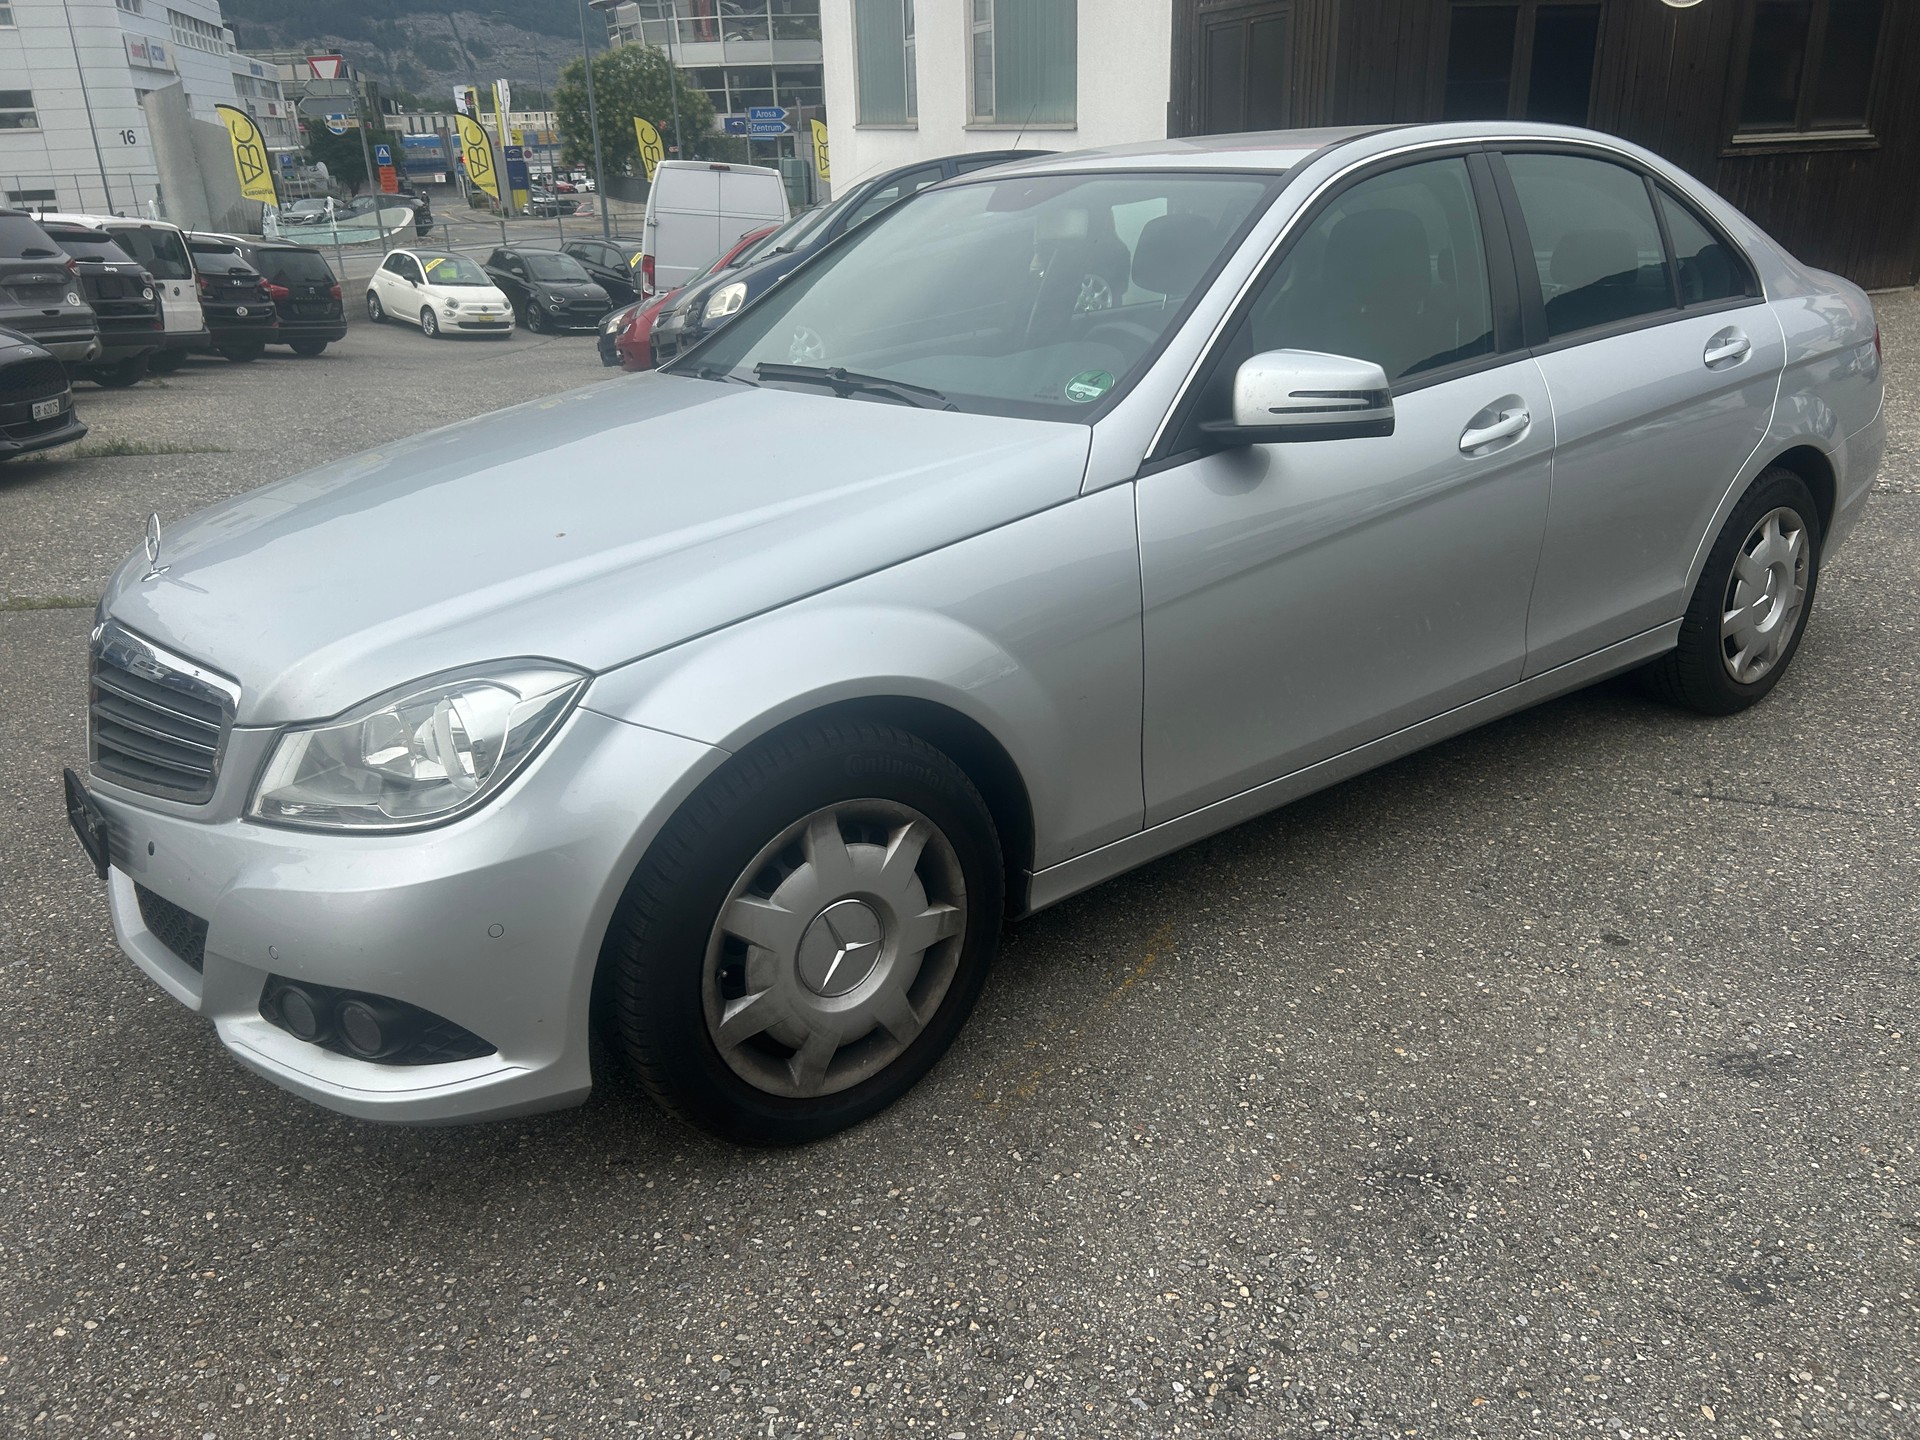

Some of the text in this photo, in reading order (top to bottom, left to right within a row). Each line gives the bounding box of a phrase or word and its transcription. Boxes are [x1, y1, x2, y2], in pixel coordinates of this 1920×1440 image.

[756, 110, 777, 118] Arosa
[752, 124, 782, 132] Zentrum
[119, 129, 137, 145] 16
[1088, 372, 1105, 386] 4
[844, 753, 947, 791] Continental
